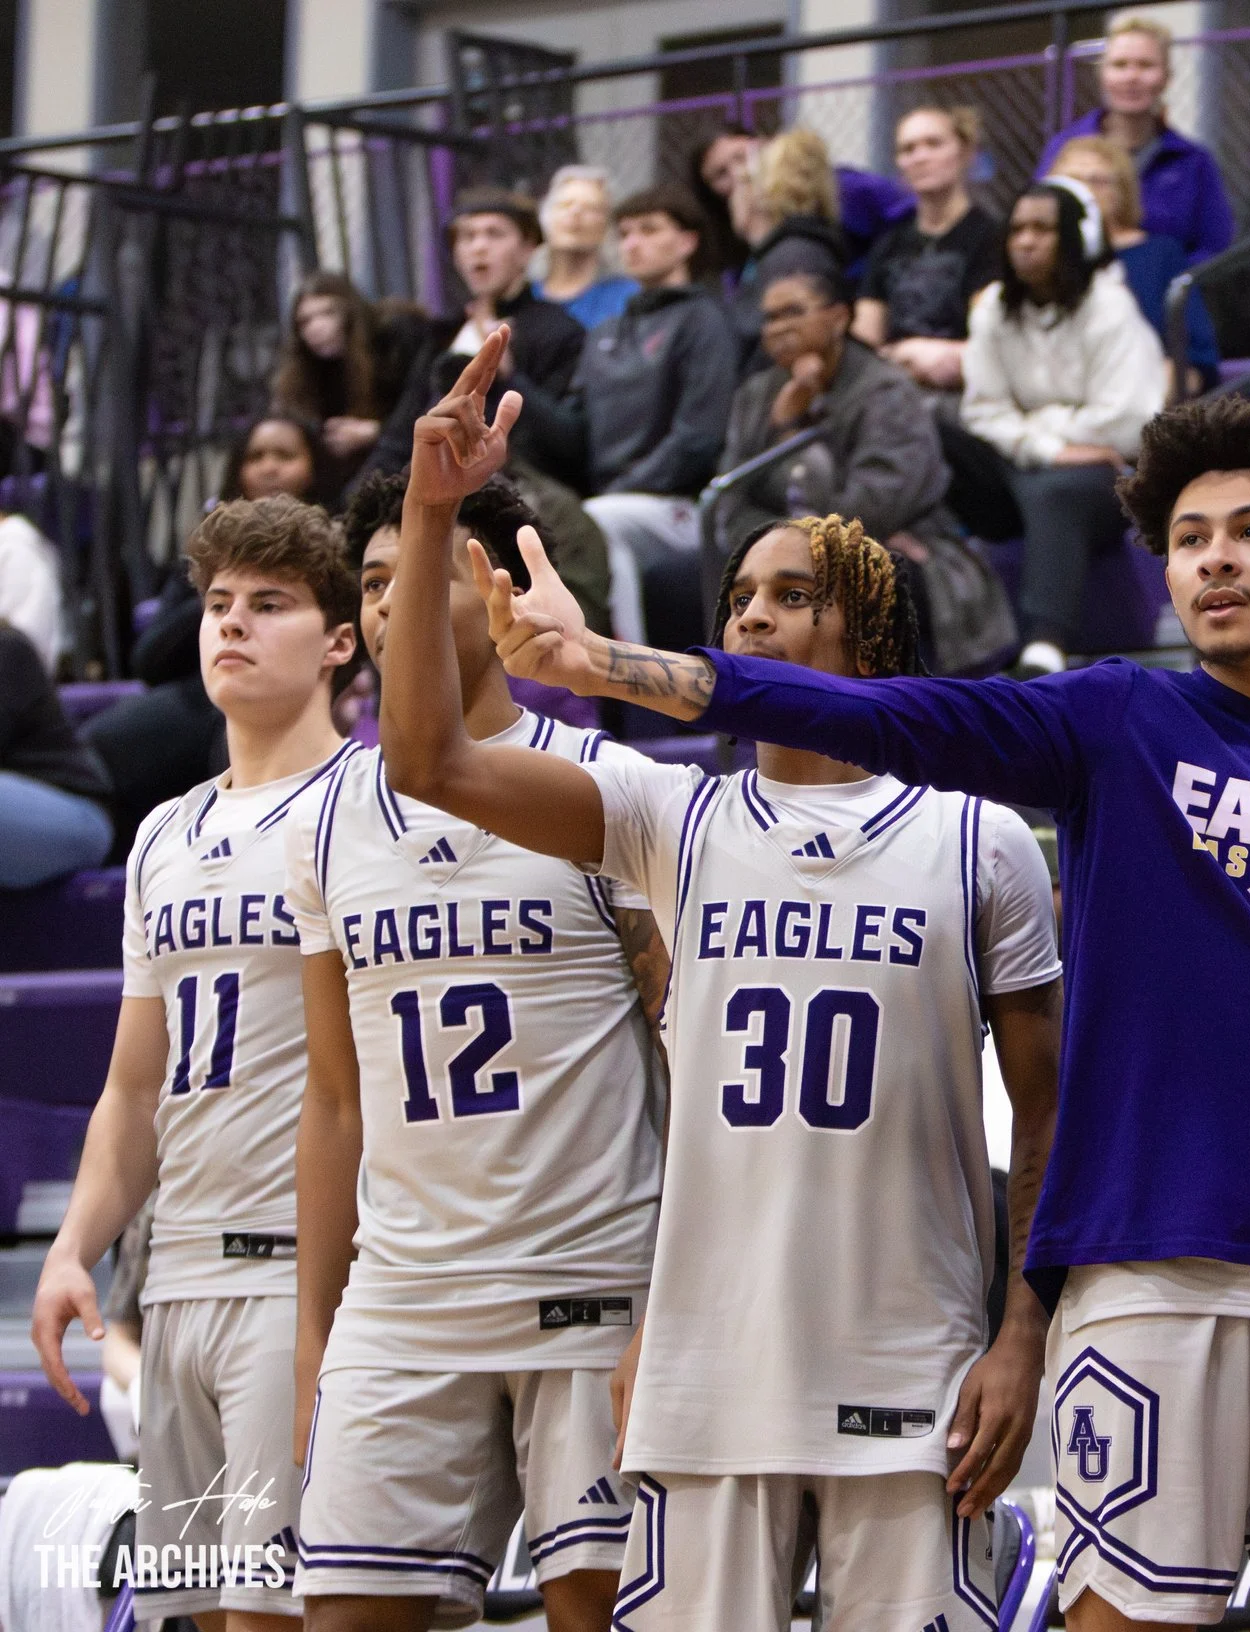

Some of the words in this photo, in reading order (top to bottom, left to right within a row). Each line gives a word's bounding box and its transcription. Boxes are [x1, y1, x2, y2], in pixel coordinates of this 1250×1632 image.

[341, 899, 555, 970] EAGLES
[696, 898, 928, 969] EAGLES
[169, 972, 241, 1095] 11
[390, 982, 524, 1126] 12
[718, 982, 884, 1134] 30
